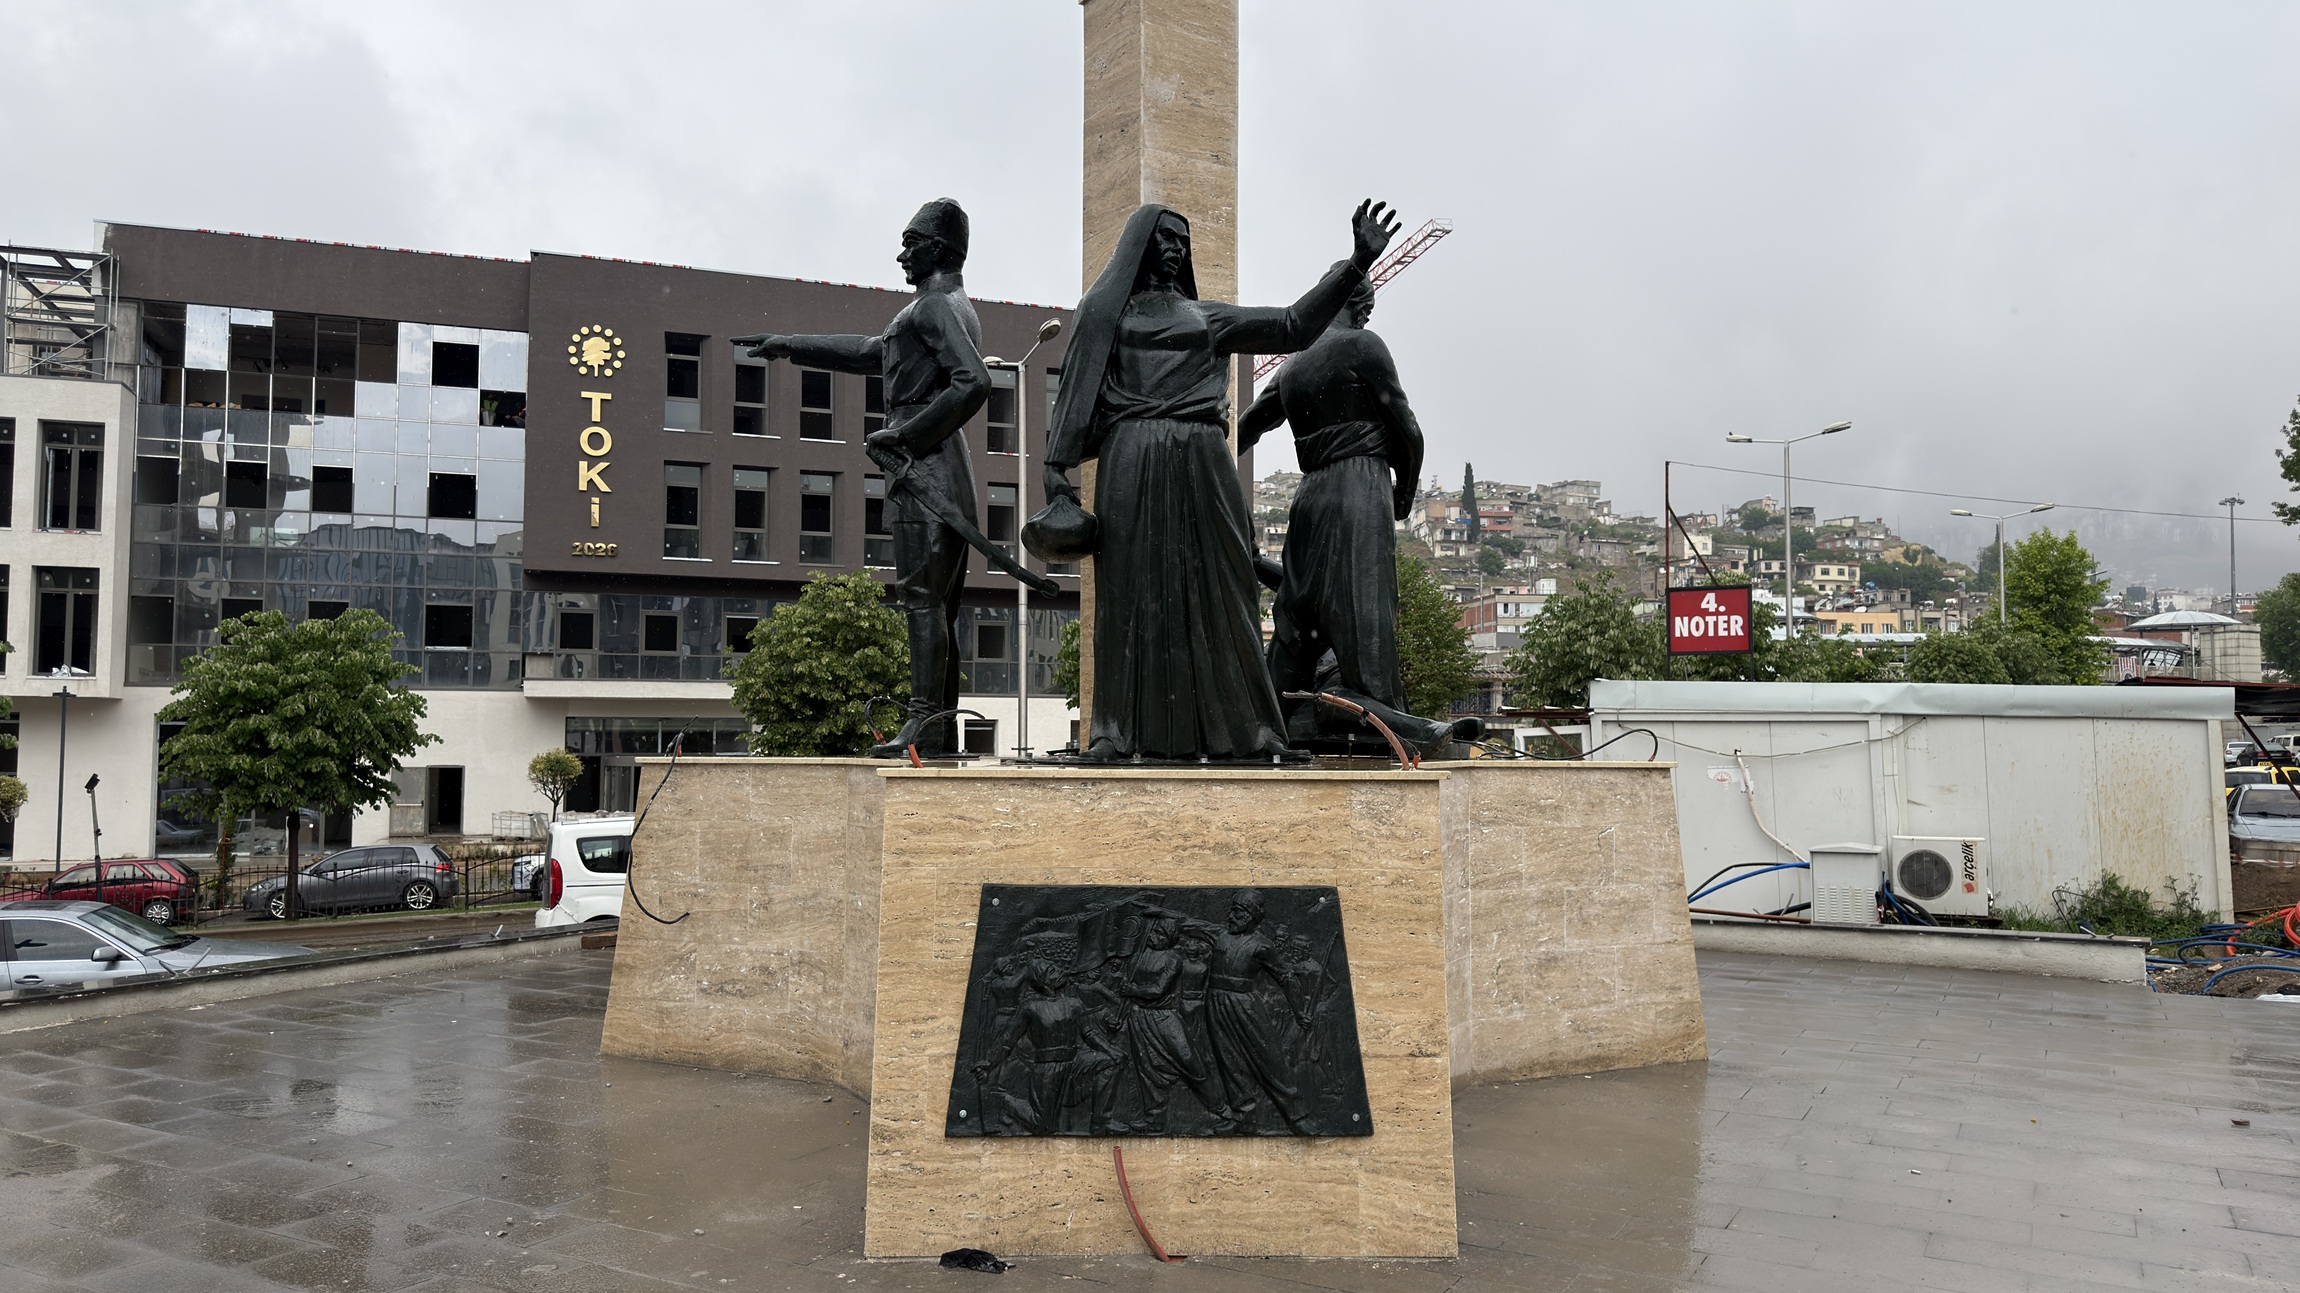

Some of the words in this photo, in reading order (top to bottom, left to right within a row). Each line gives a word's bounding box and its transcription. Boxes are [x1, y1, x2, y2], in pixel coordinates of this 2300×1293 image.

[1700, 592, 1727, 613] 4.
[1674, 614, 1745, 638] NOTER
[1961, 839, 1977, 882] arçelik
